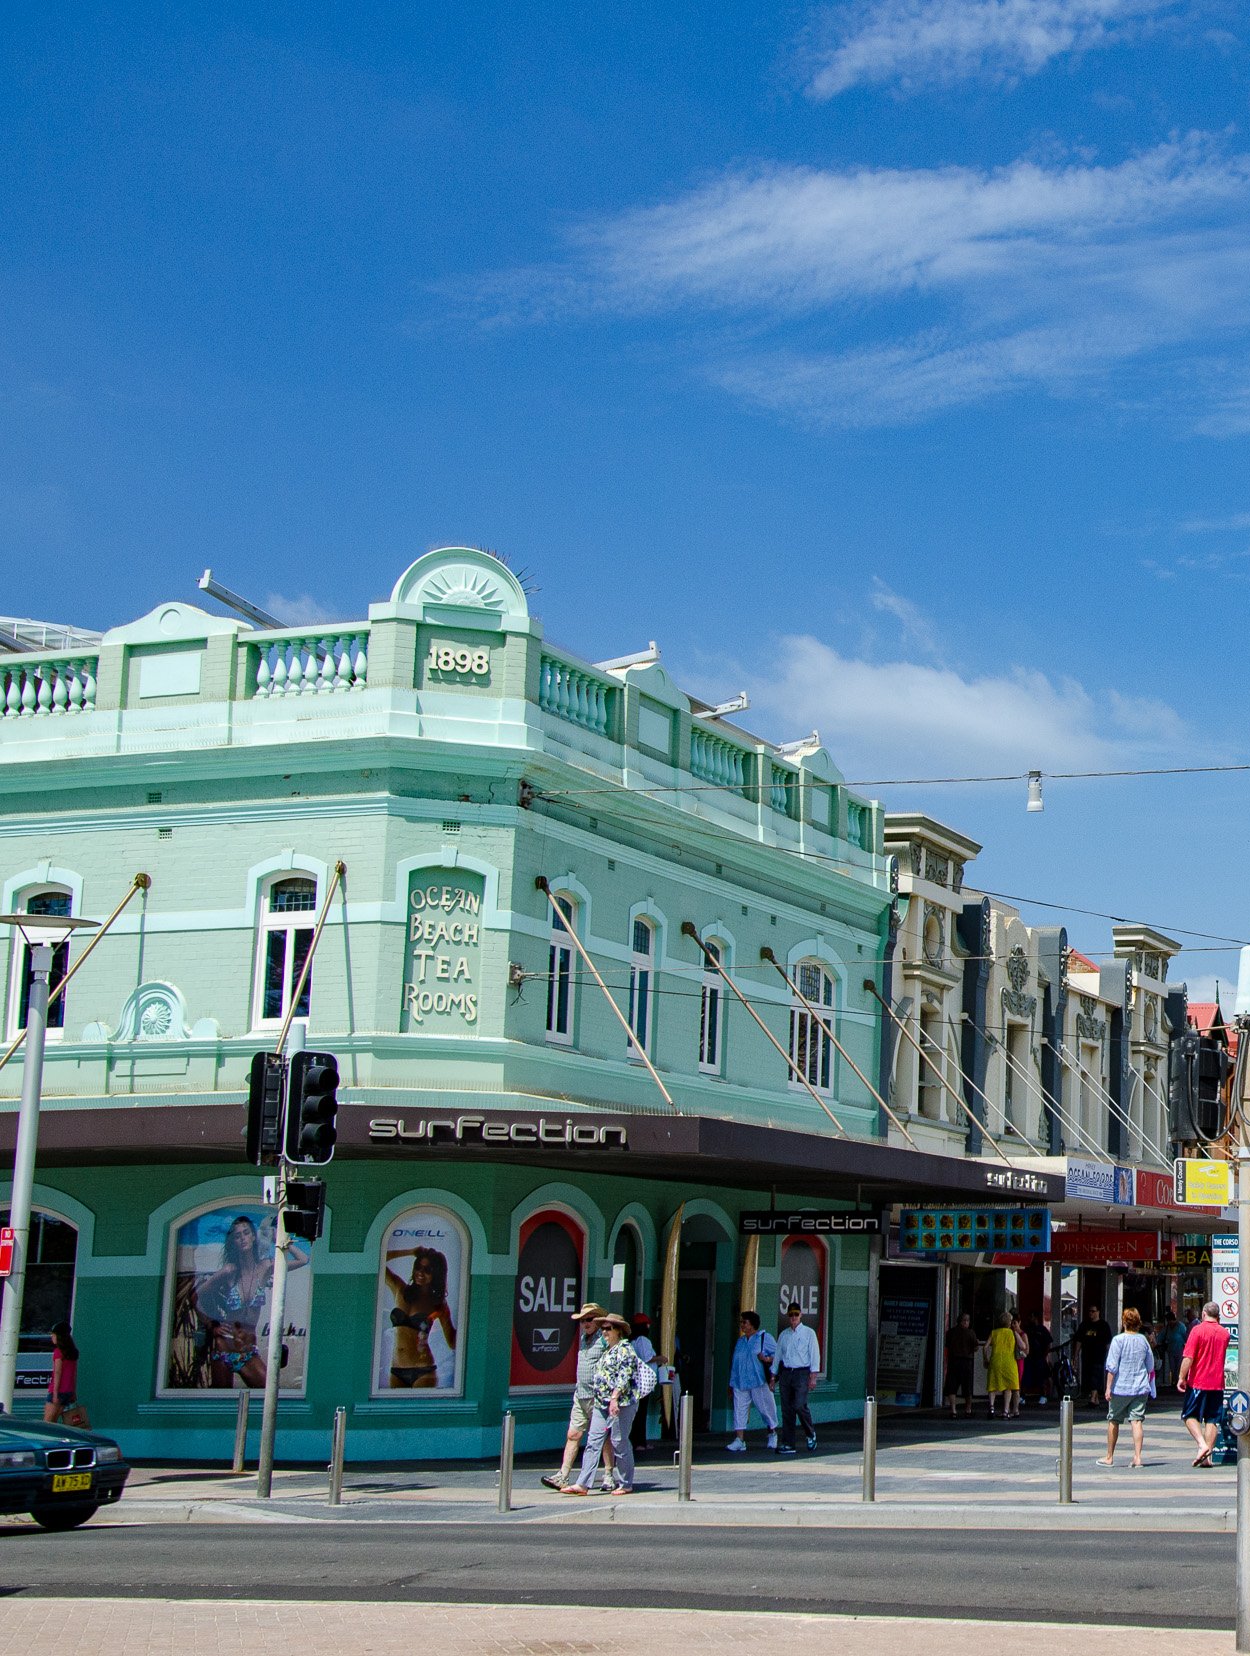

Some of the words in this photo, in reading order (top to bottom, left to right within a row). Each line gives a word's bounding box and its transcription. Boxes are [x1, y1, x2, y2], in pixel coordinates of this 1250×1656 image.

[428, 645, 490, 675] 1898
[410, 886, 481, 913] OCEAN
[409, 913, 479, 947] BEACH
[413, 949, 472, 982] TEA
[402, 982, 478, 1022] ROOMS
[368, 1115, 628, 1144] surfection
[743, 1215, 879, 1230] surfection
[1213, 1238, 1222, 1246] THE
[1222, 1238, 1239, 1246] CORSO
[519, 1275, 577, 1313] SALE
[779, 1284, 818, 1315] SALE
